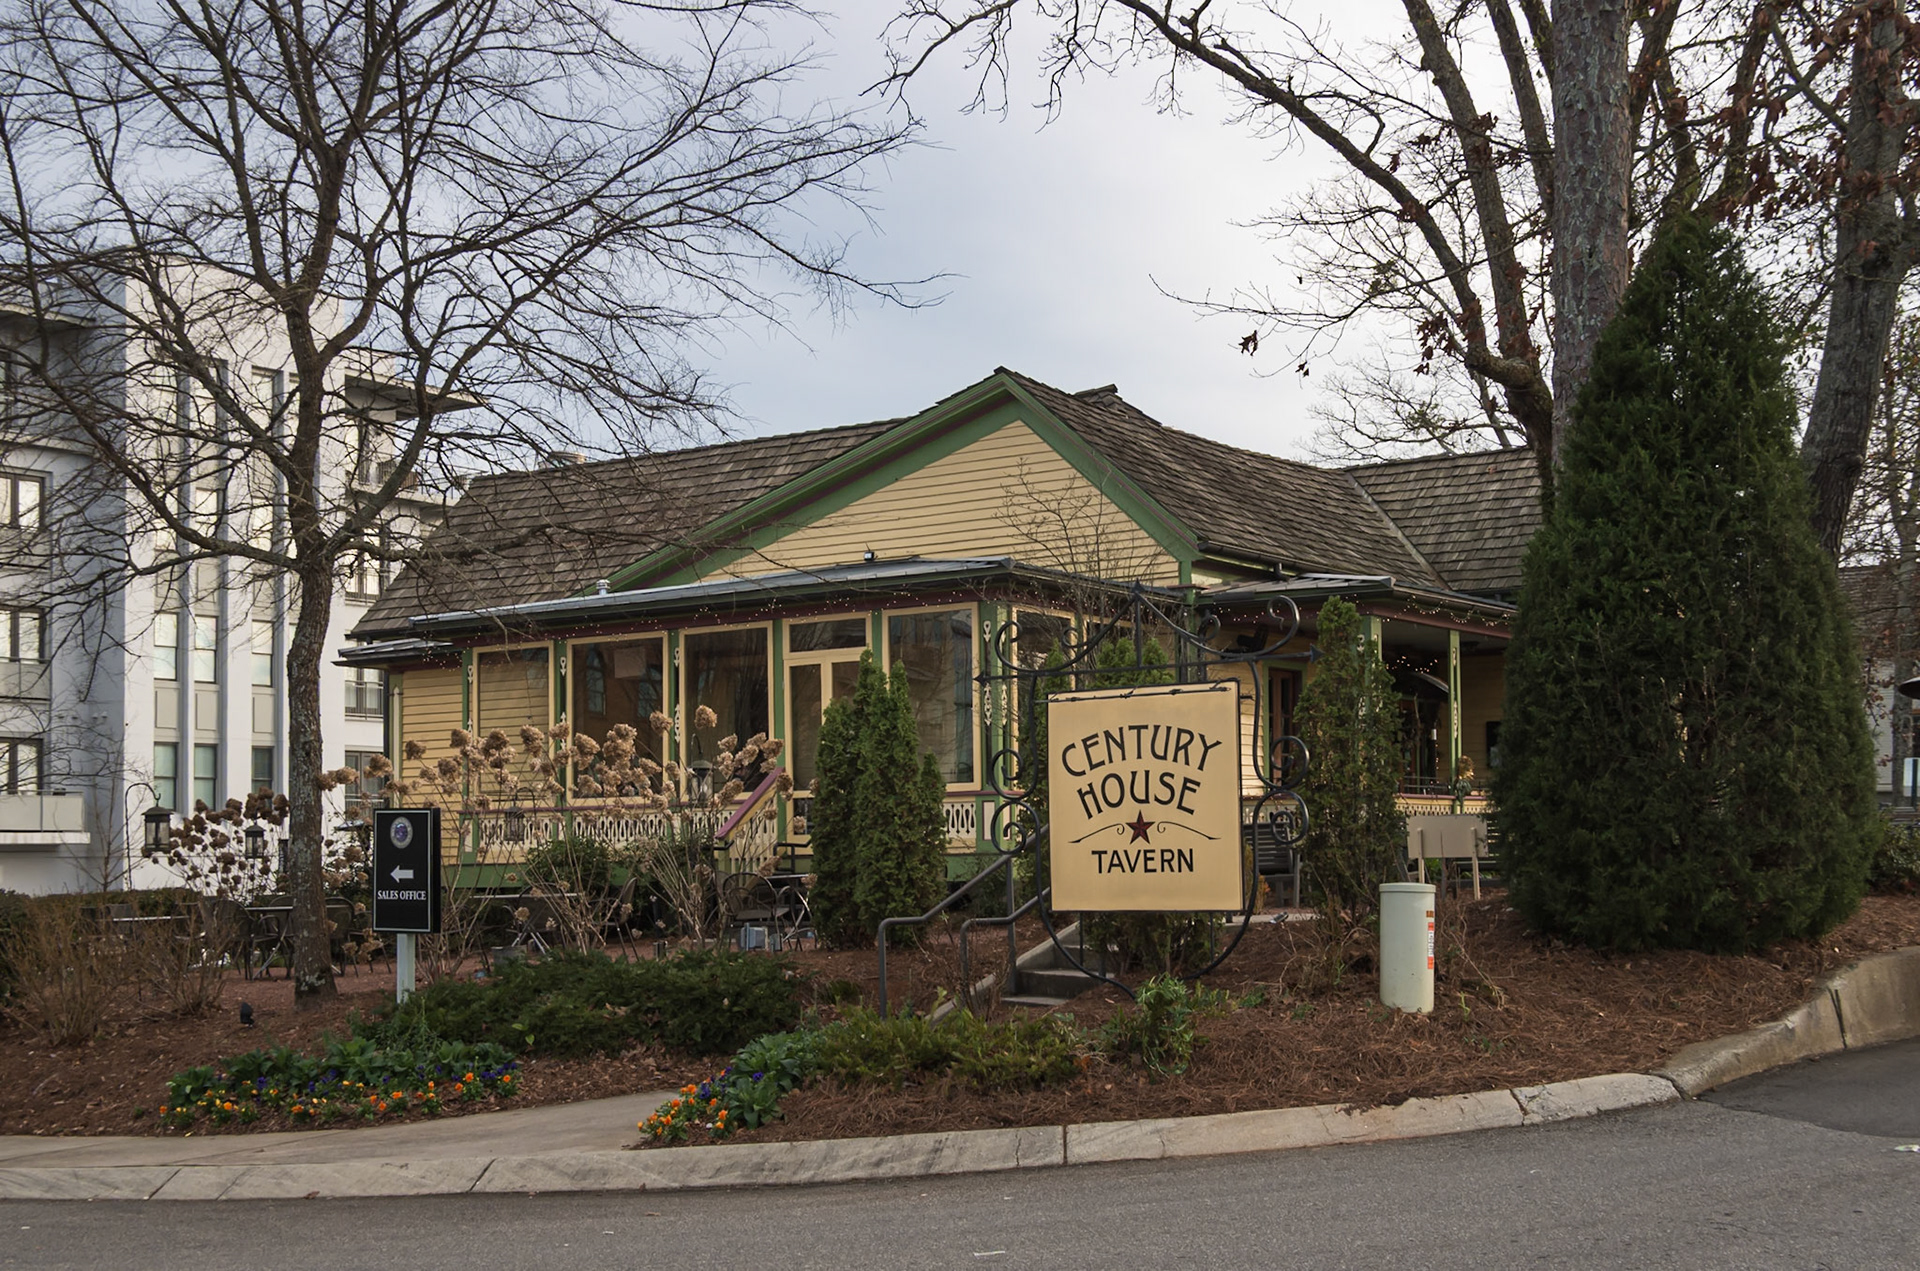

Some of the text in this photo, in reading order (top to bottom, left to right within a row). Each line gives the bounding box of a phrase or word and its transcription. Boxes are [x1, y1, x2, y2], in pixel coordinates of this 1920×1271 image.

[1061, 724, 1223, 777] CENTURY
[1076, 769, 1201, 820] HOUSE
[1091, 848, 1194, 874] TAVERN
[377, 890, 427, 900] SALES OFFICE
